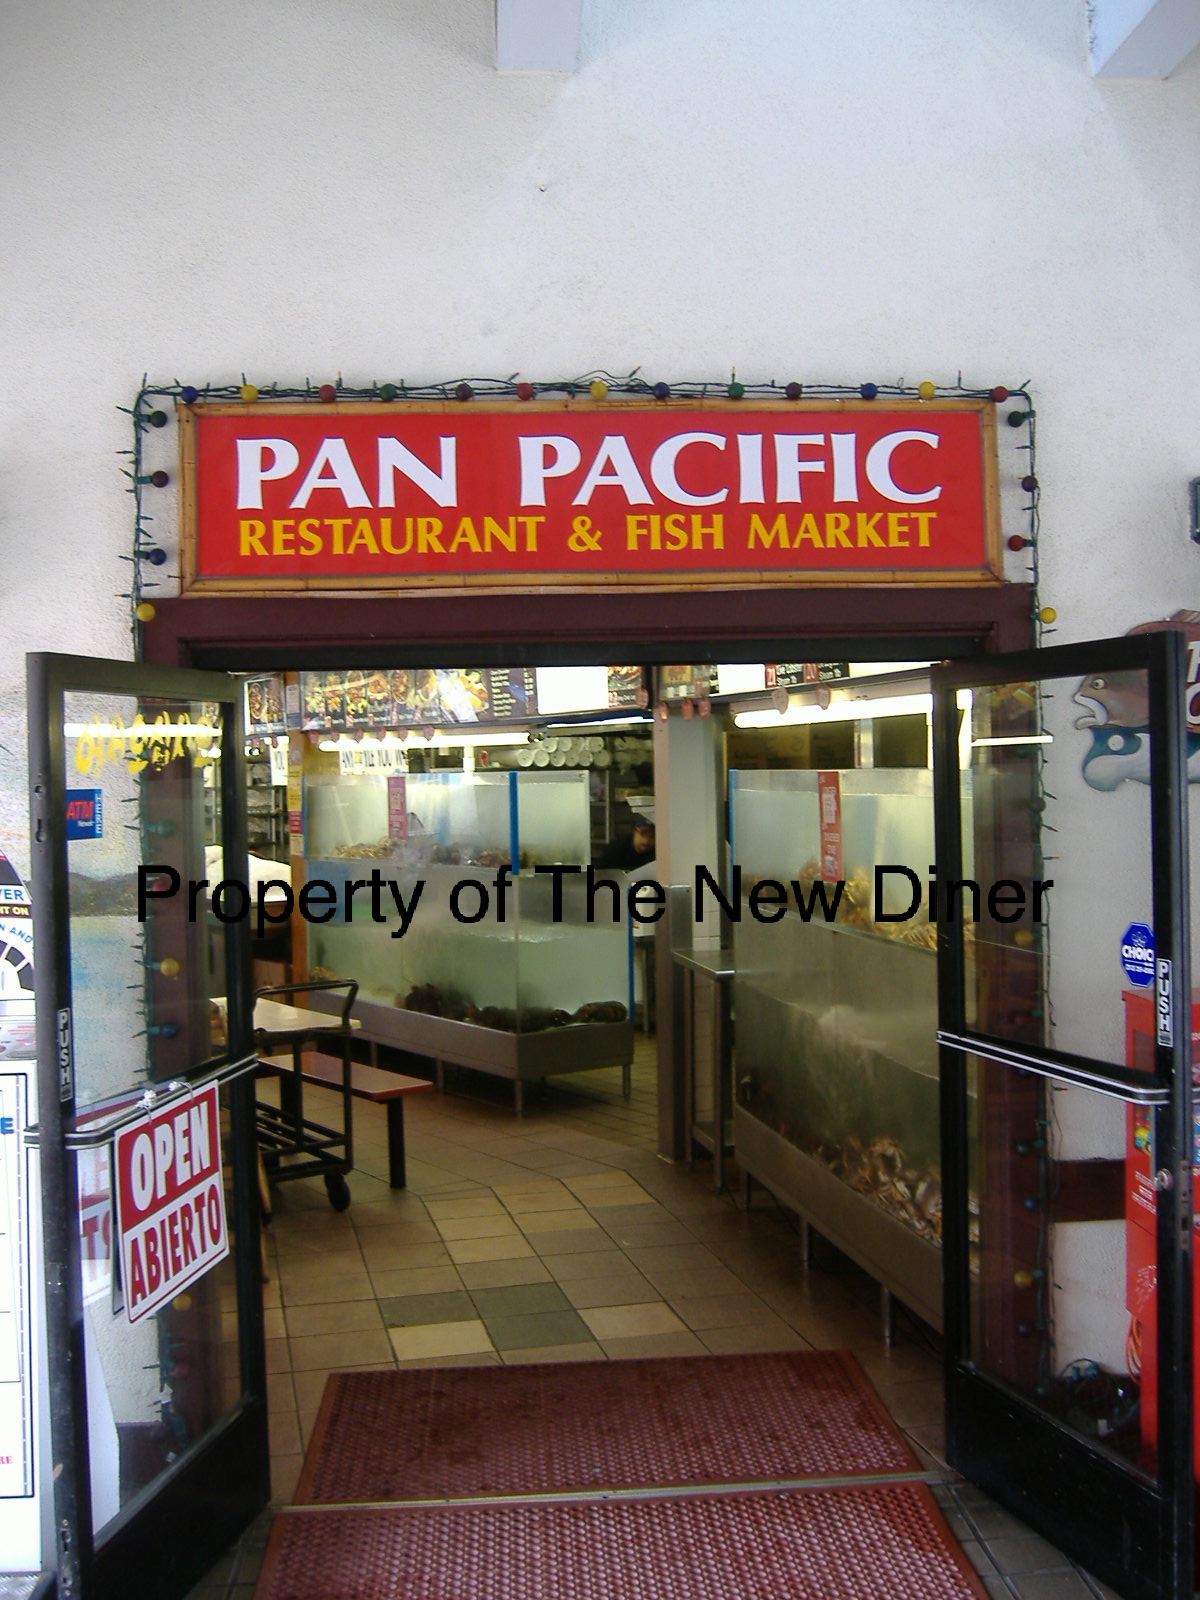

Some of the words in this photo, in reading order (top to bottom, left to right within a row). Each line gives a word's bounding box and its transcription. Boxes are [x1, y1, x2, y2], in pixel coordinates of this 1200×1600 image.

[235, 436, 457, 510] PAN
[518, 430, 942, 507] PACIFIC
[239, 515, 546, 556] RESTAURANT
[567, 515, 602, 552] &
[626, 514, 724, 551] FISH
[747, 511, 938, 550] MARKET
[66, 800, 95, 819] ATM
[9, 926, 33, 943] AND
[12, 906, 29, 915] ON
[1159, 961, 1170, 1031] PUSH
[60, 1011, 70, 1086] PUSH
[131, 1100, 211, 1212] OPEN
[131, 1183, 222, 1309] ABIERTO
